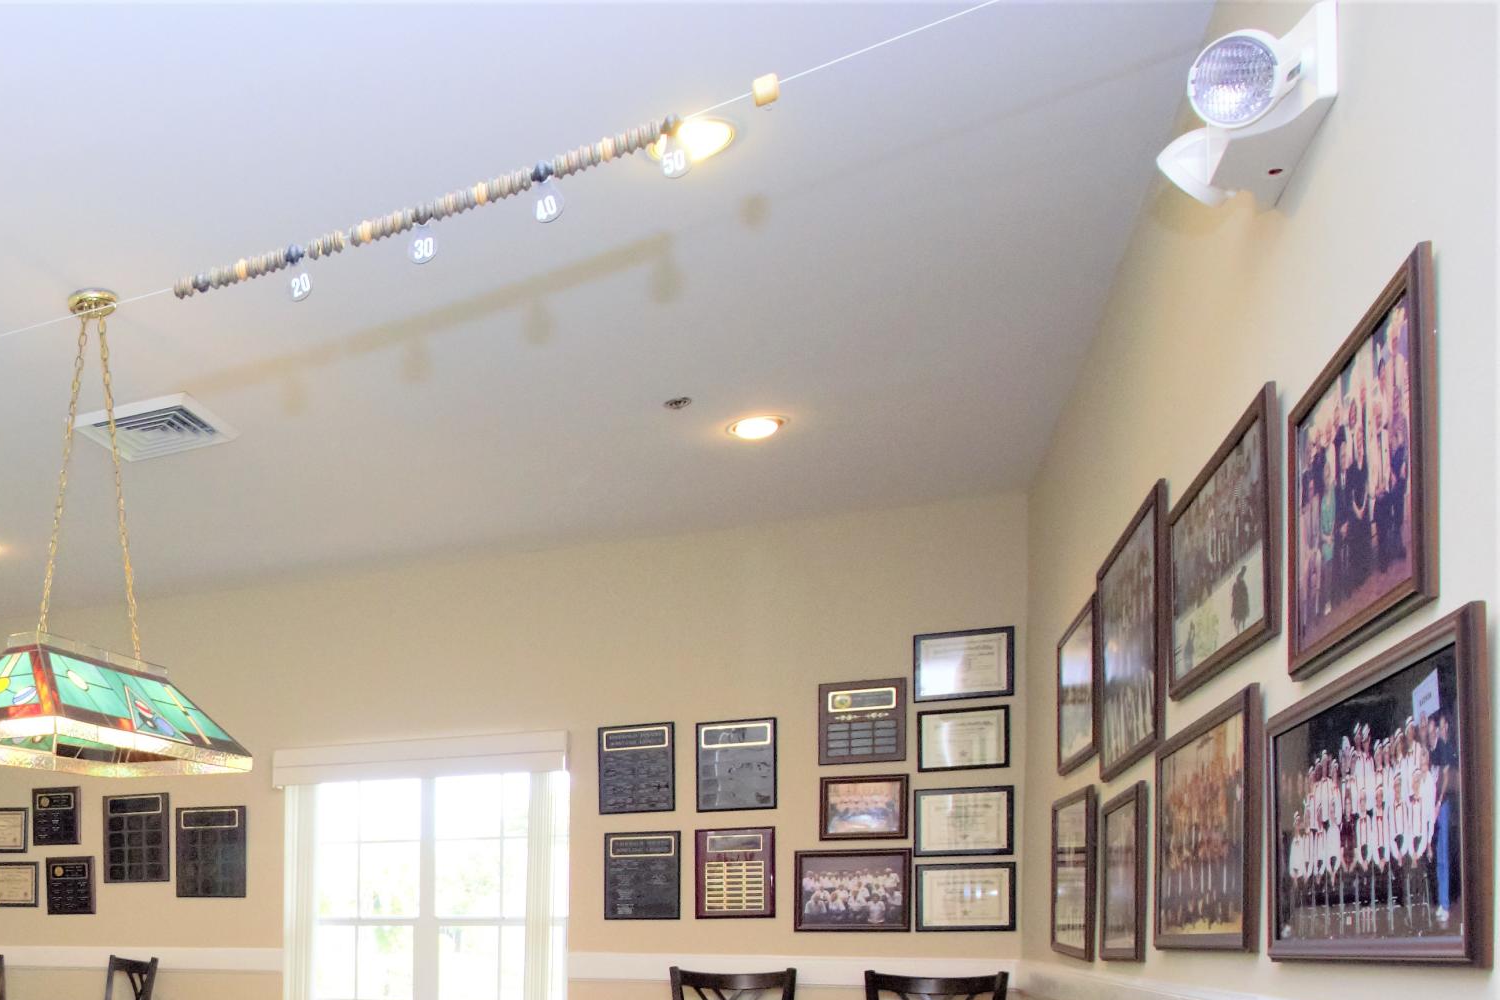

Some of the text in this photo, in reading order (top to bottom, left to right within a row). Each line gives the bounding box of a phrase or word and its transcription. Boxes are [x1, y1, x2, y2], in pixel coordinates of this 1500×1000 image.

[663, 148, 685, 176] 50
[536, 195, 557, 220] 40
[414, 237, 434, 259] 30
[291, 273, 311, 298] 20
